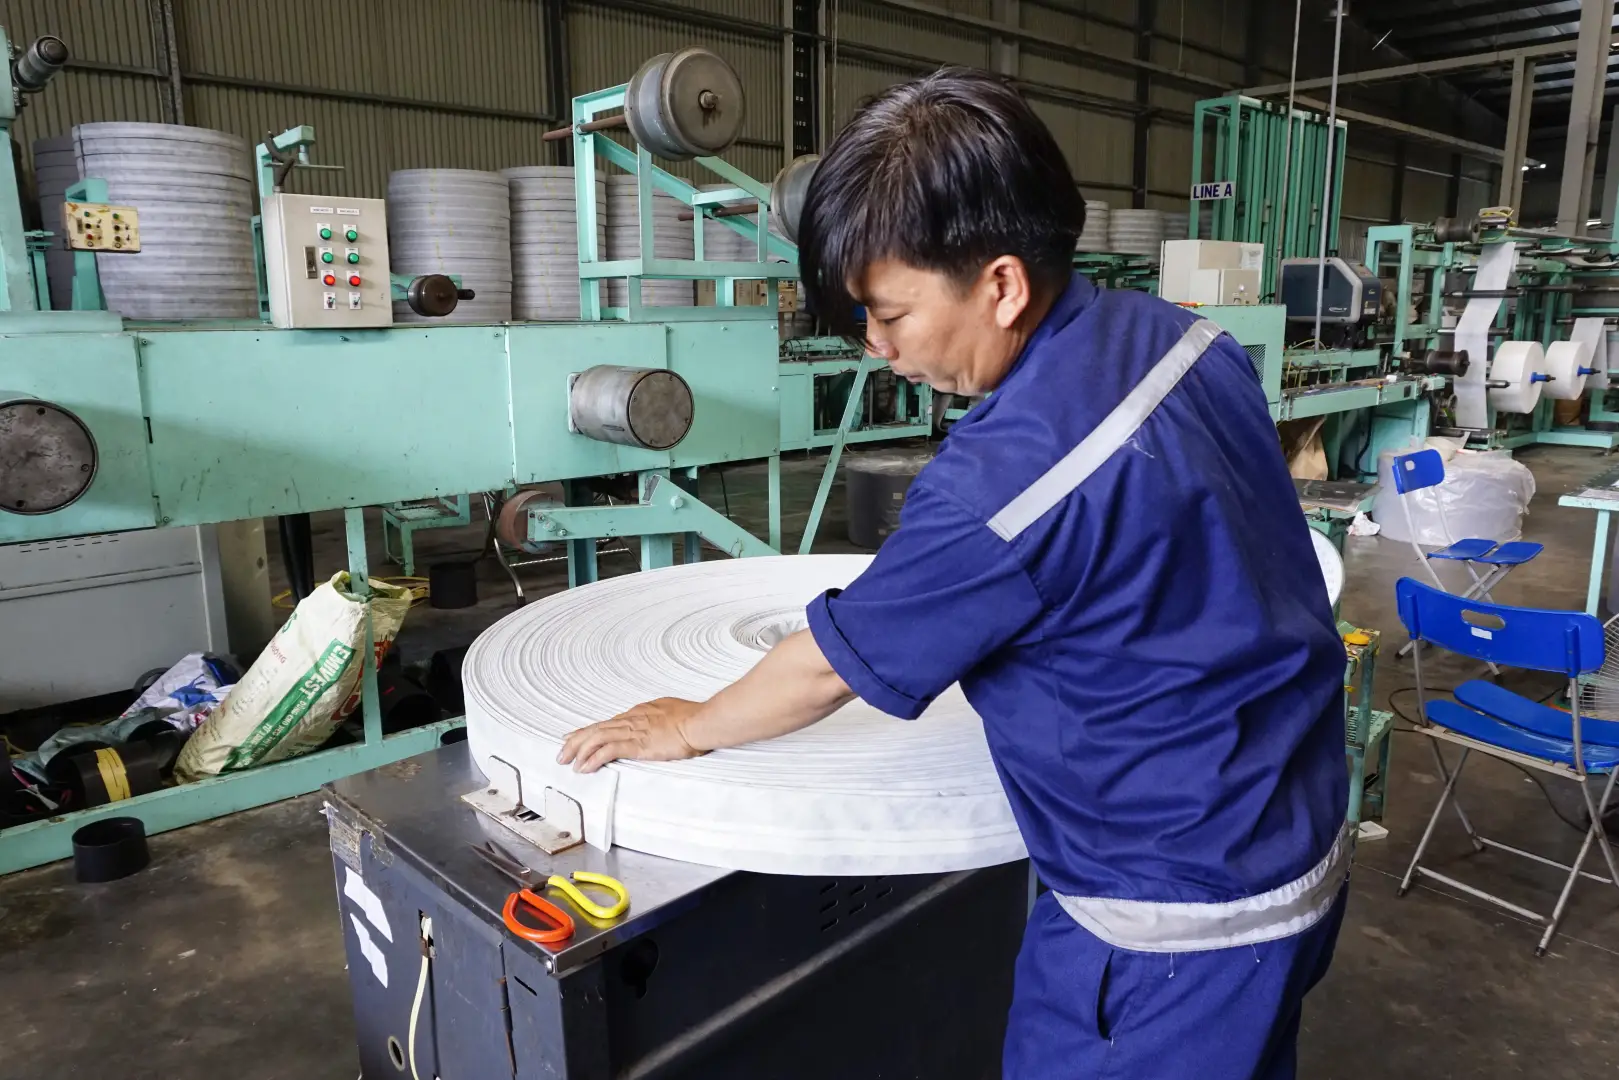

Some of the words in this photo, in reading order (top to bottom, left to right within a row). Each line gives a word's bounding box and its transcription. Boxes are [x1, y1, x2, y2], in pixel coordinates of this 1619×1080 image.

[1193, 184, 1220, 199] LINE
[1224, 183, 1232, 197] A
[299, 645, 351, 700] EMIVEST
